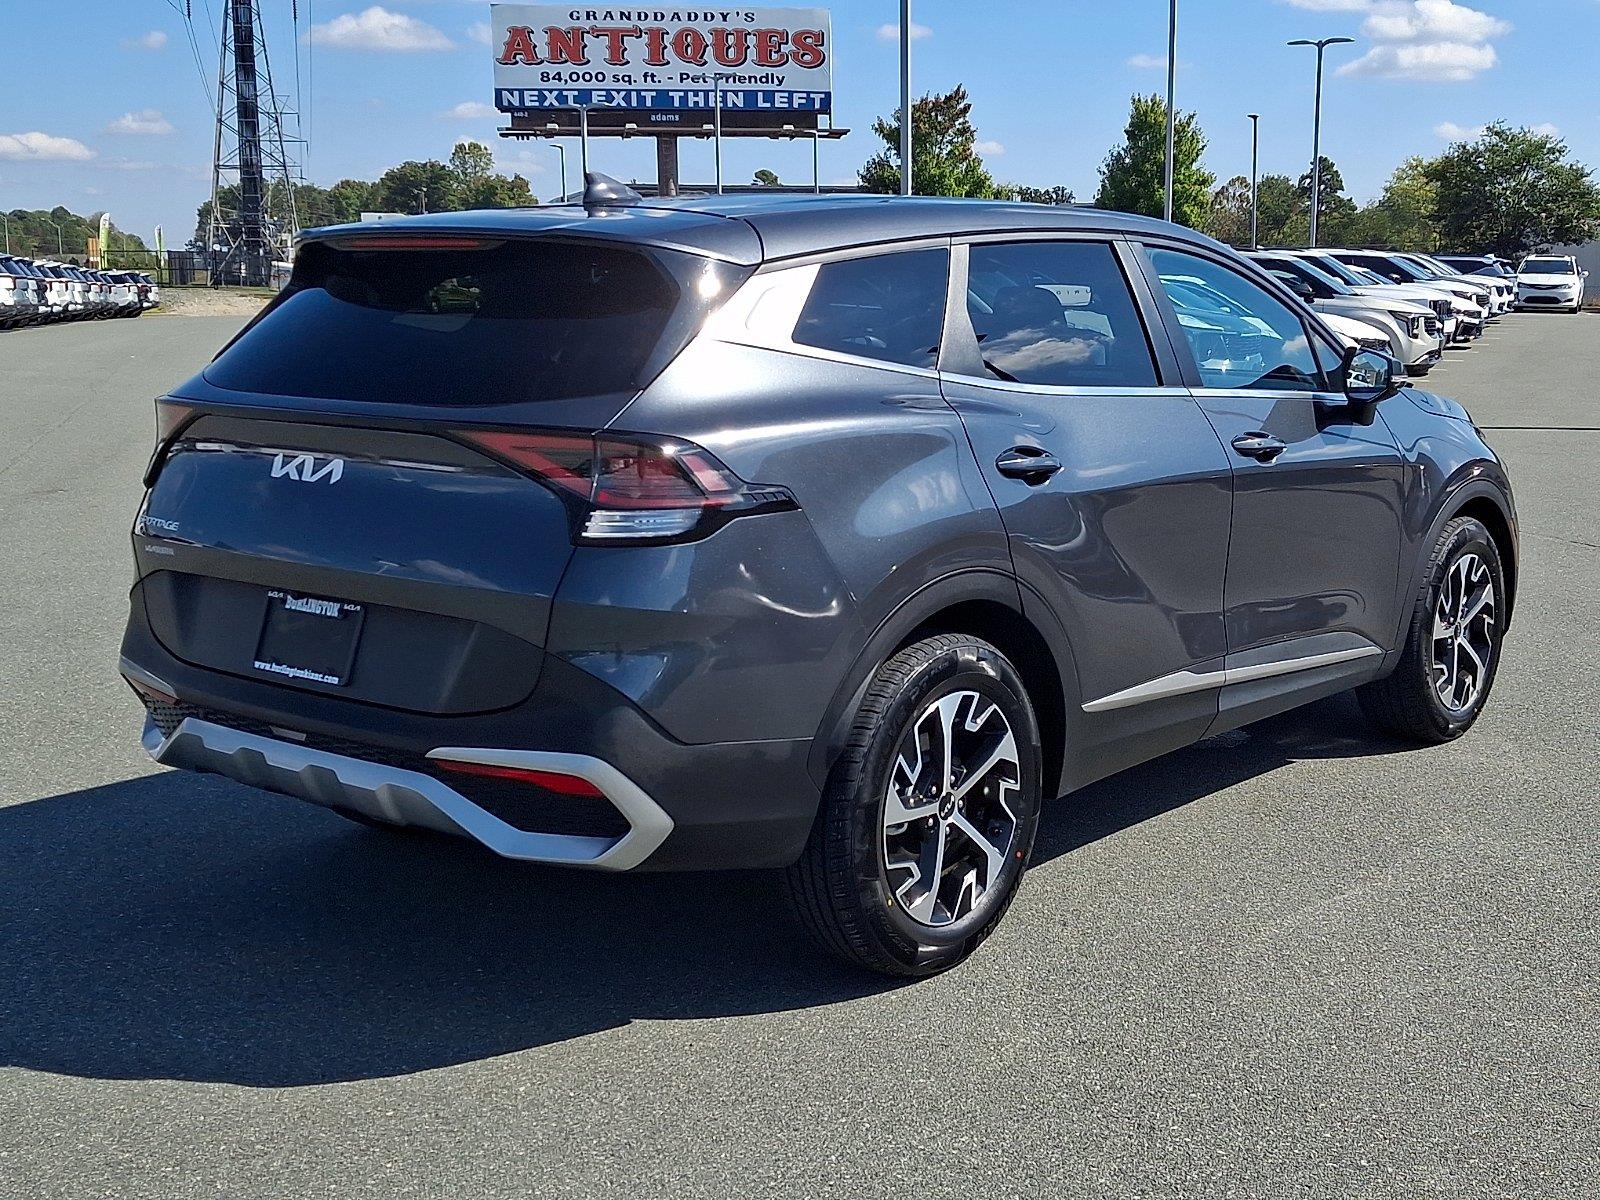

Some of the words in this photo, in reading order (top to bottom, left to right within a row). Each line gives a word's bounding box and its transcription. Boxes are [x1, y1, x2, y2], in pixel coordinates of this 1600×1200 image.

[569, 10, 756, 22] GRANDDADDY'S
[496, 25, 826, 68] ANTIQUES
[540, 71, 606, 85] 84,000
[612, 73, 637, 85] sq.
[643, 71, 662, 83] ft.
[679, 72, 709, 84] Pet
[502, 90, 579, 107] NEXT
[592, 90, 656, 107] EXIT
[669, 91, 744, 108] THEN
[757, 92, 825, 109] LEFT
[650, 113, 680, 121] adams
[270, 453, 344, 485] KIA
[284, 594, 341, 617] BURLINGTON
